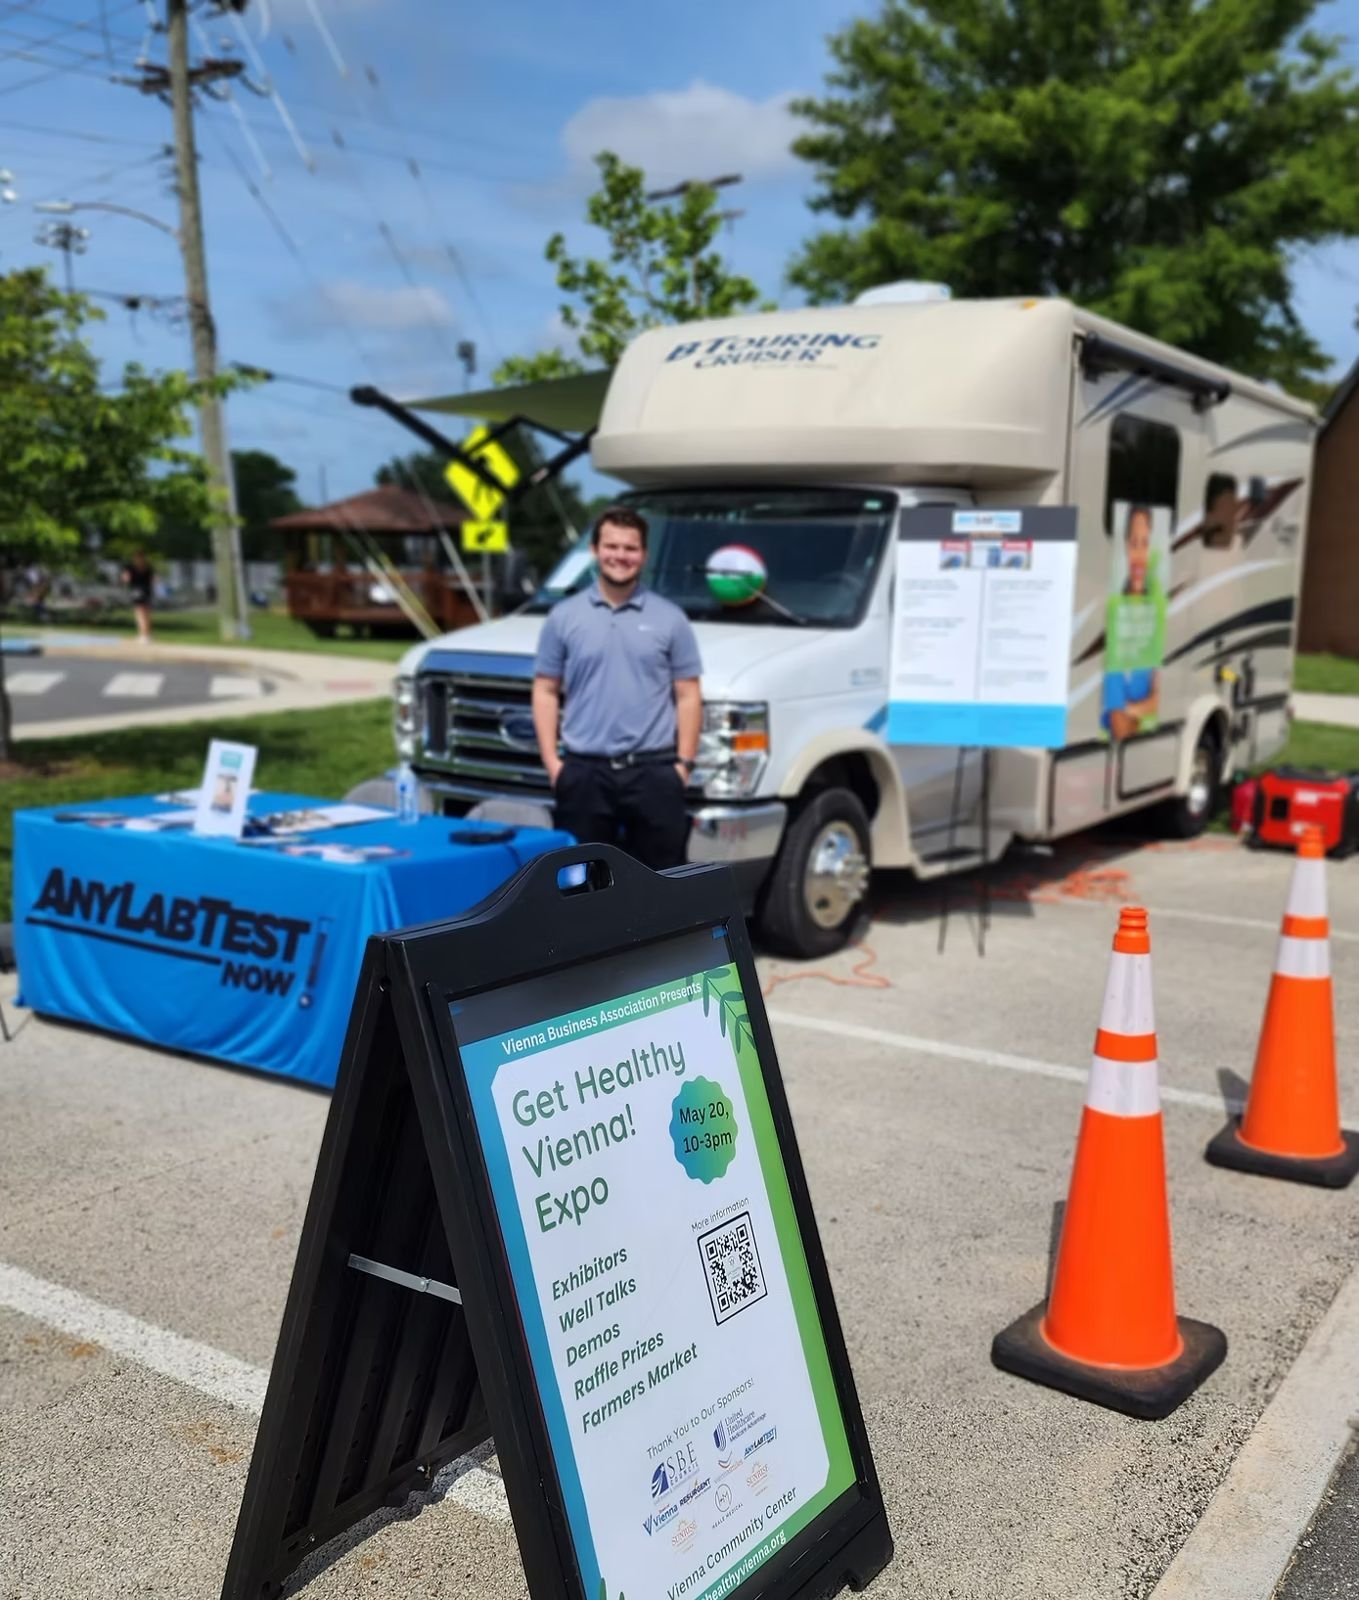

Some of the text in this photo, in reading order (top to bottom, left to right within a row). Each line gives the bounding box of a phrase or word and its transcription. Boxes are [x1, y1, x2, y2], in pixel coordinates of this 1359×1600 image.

[220, 960, 296, 997] NOW
[502, 982, 702, 1055] Vienna Business Association Presents
[513, 1041, 686, 1127] Get Healthy
[679, 1101, 730, 1125] May 20,
[522, 1103, 637, 1178] Vienna!
[684, 1130, 733, 1154] 10-3pm
[534, 1176, 609, 1233] Expo
[691, 1217, 709, 1232] More
[552, 1248, 627, 1301] Exhibitors
[559, 1278, 637, 1333] Well Talks
[566, 1323, 621, 1367] Demos
[574, 1332, 664, 1400] Raffle Prizes
[582, 1342, 698, 1433] Farmers Market
[647, 1377, 754, 1459] Thank You to Our Sponsors!
[724, 1408, 743, 1426] United
[727, 1411, 755, 1436] Healthcare
[653, 1505, 679, 1527] Vienna
[680, 1477, 711, 1506] RESURGENT
[667, 1565, 706, 1600] Vienna
[706, 1513, 764, 1569] Community
[765, 1487, 797, 1519] Center
